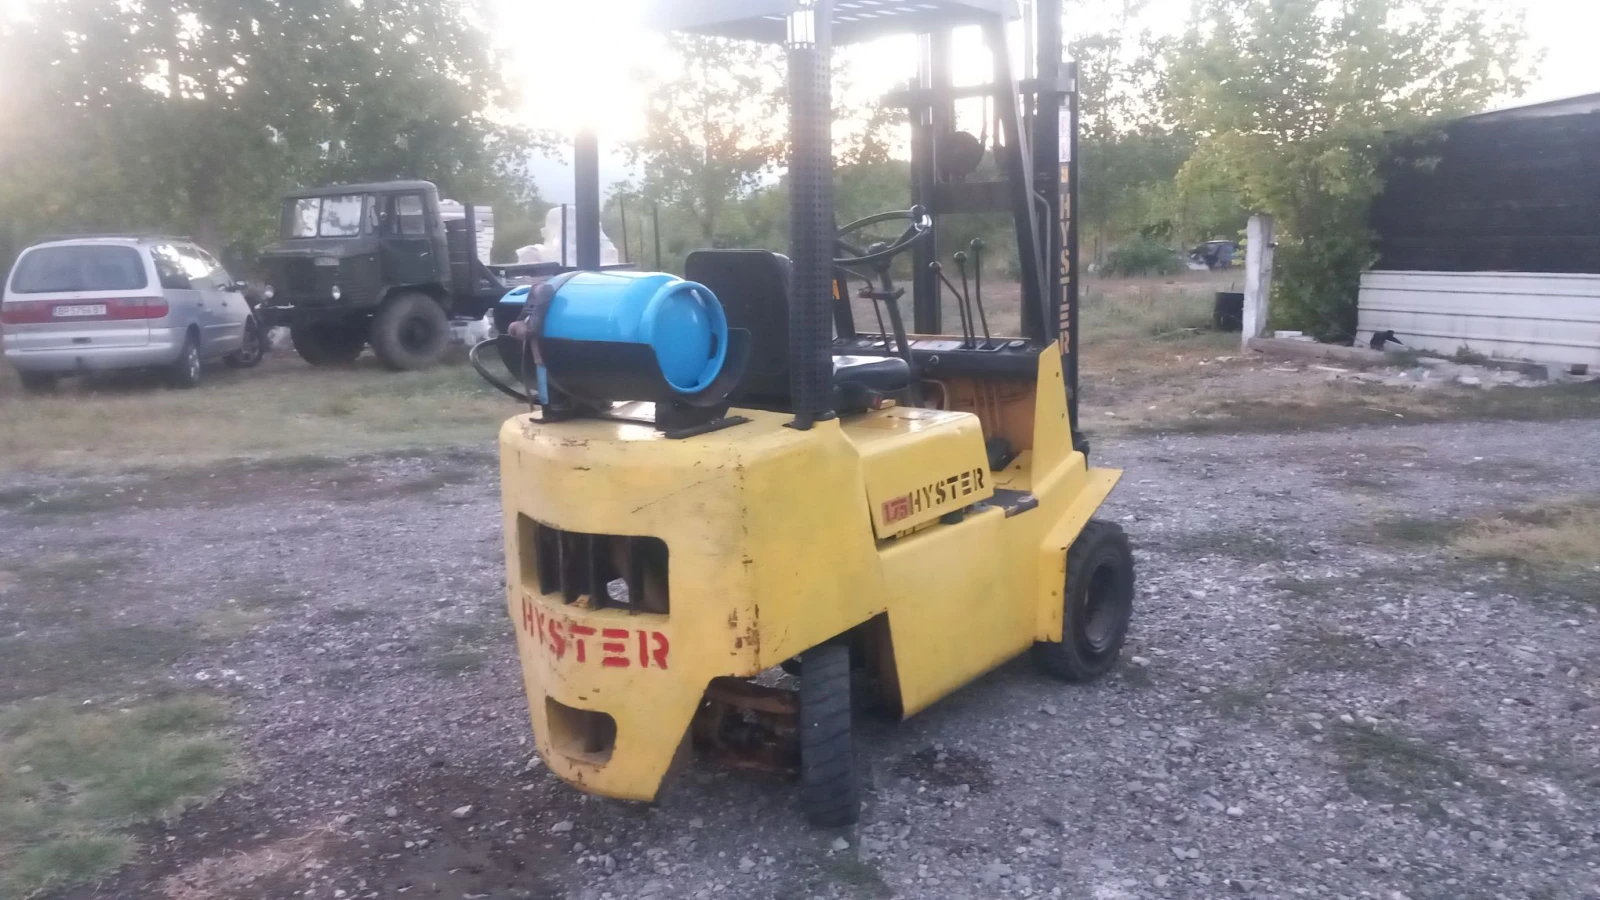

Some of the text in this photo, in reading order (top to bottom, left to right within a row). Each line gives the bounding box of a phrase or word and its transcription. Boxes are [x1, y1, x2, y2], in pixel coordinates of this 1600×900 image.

[1059, 193, 1070, 355] HYSTER
[908, 467, 984, 515] HYSTER
[522, 597, 669, 670] HYSTER
